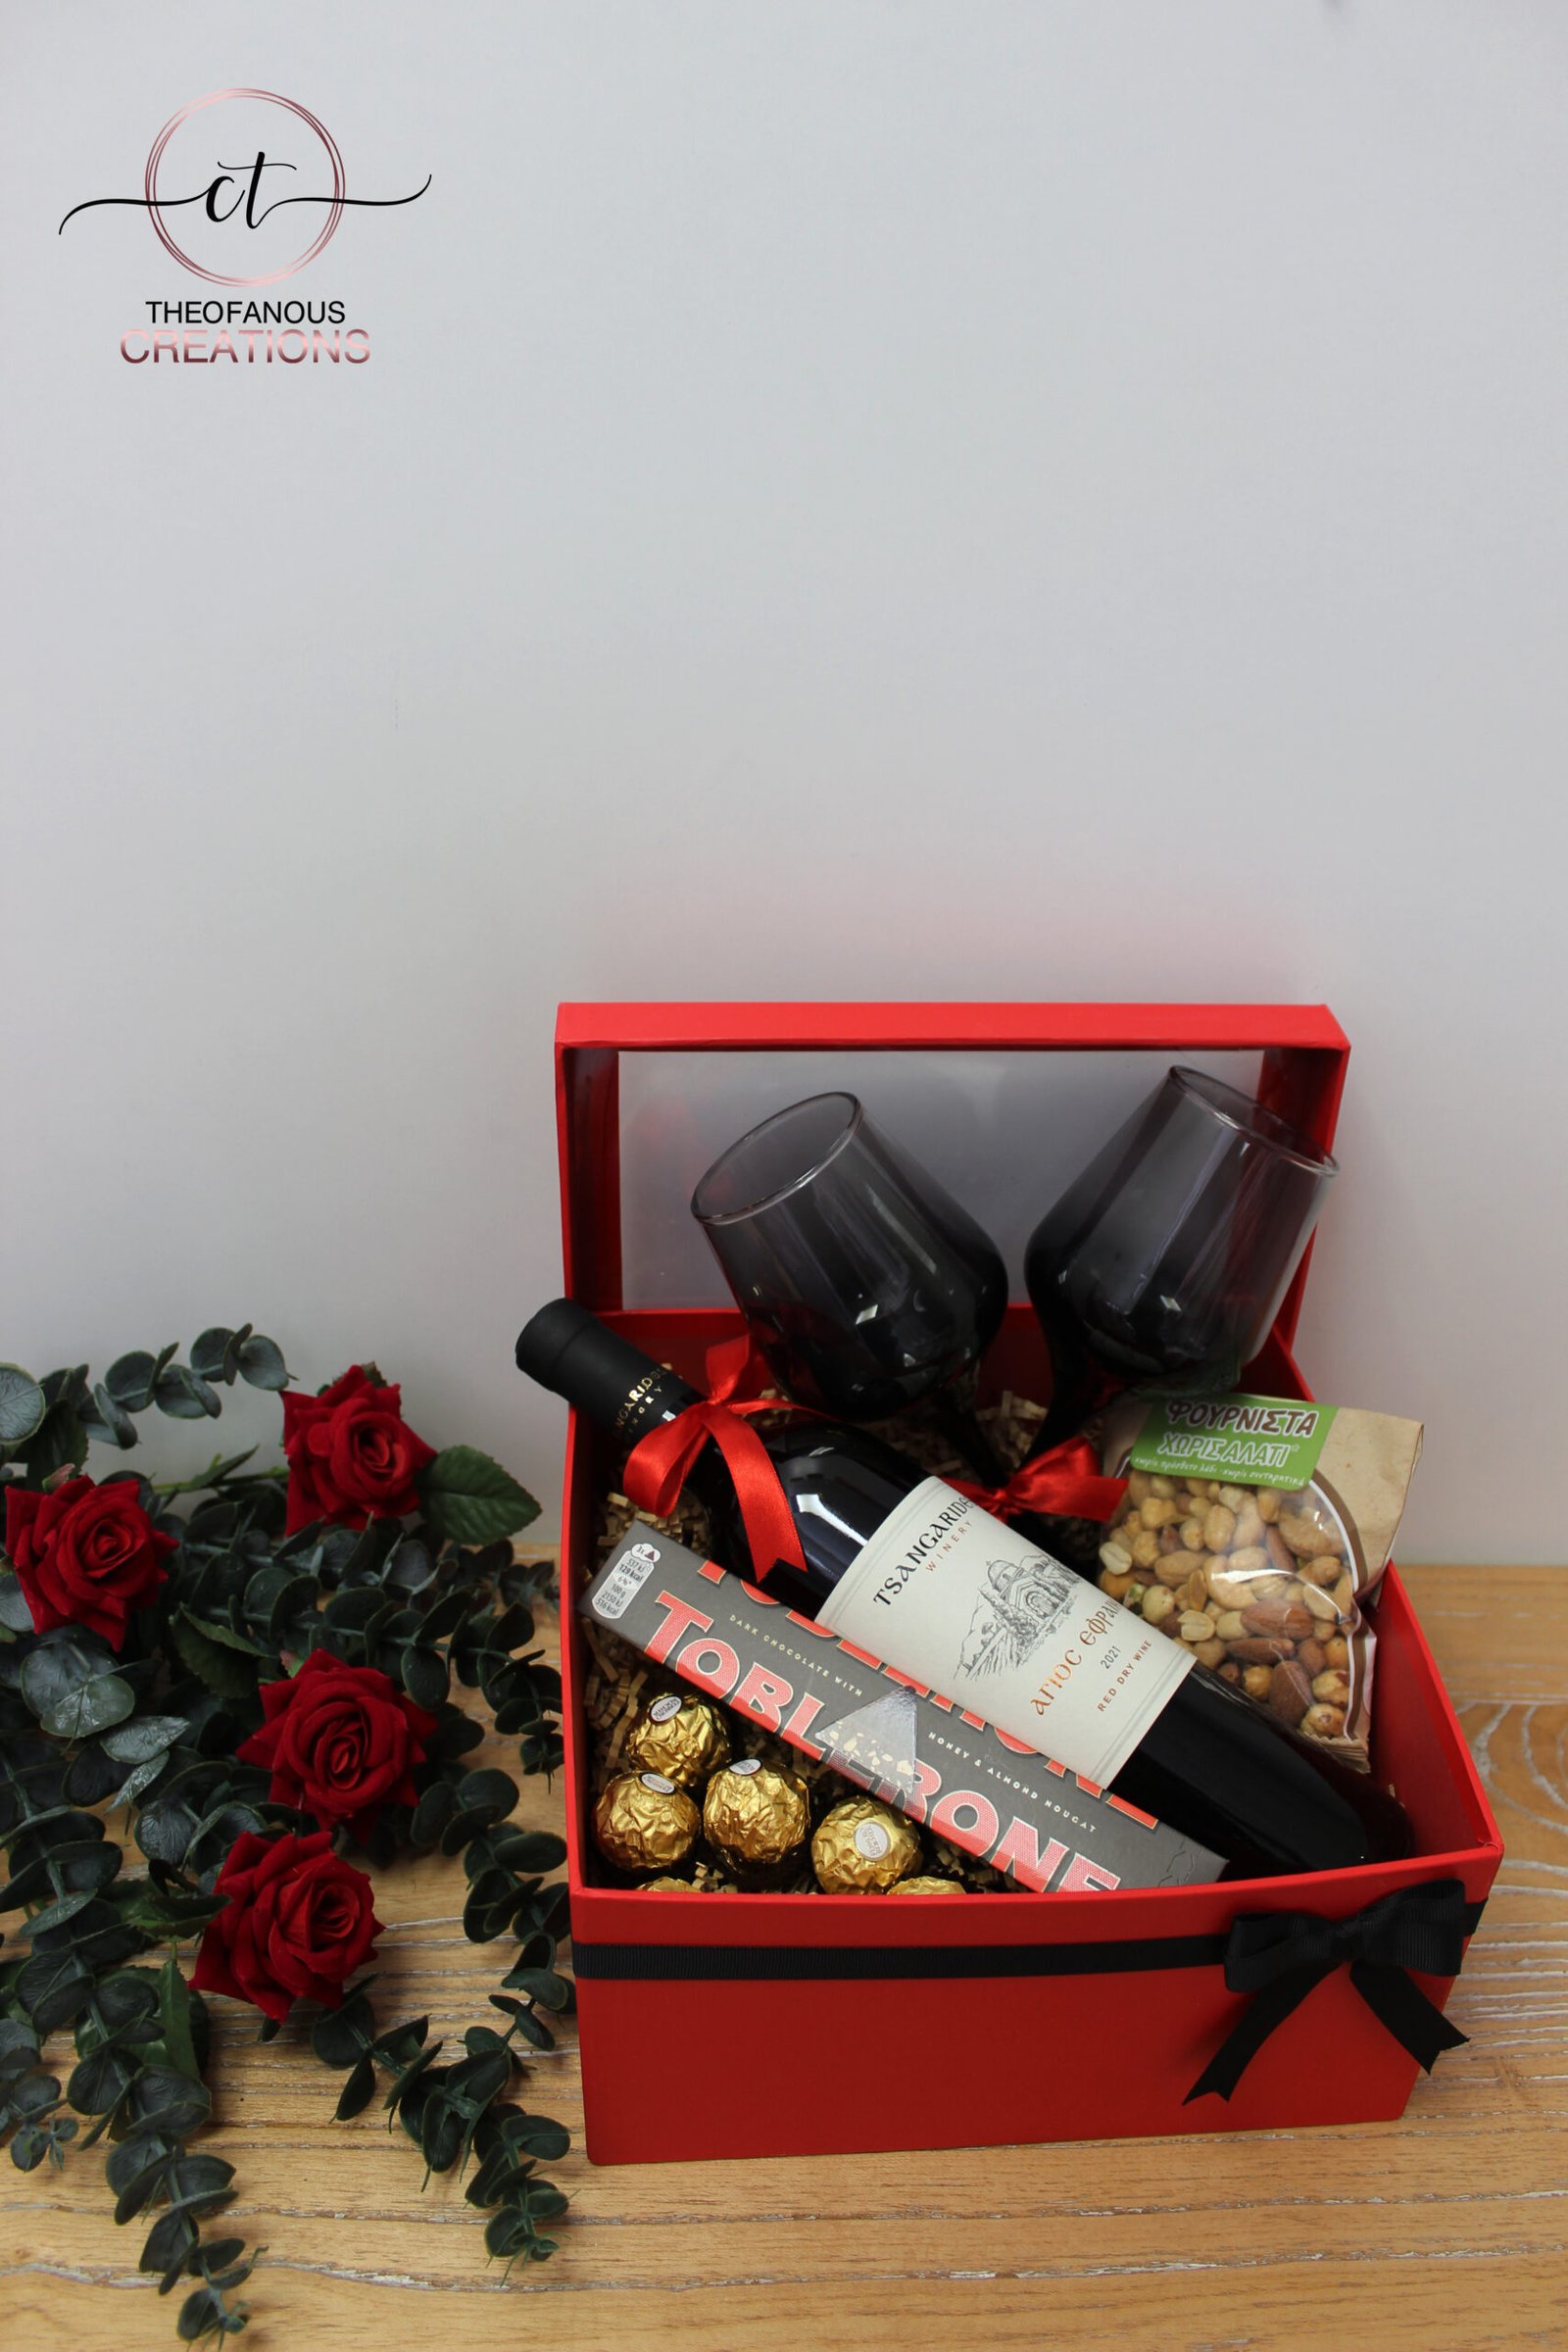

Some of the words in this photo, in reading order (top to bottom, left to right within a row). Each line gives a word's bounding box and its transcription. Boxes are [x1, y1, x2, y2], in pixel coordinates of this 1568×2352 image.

[1157, 1431, 1227, 1461] ΧΩΡΙΣ
[1166, 1401, 1319, 1439] ΦΟΥΡΝΙΣΤΑ
[873, 1496, 976, 1605] TSANGARIDE
[926, 1521, 971, 1572] WINERY
[729, 1614, 759, 1636] DARK
[763, 1635, 830, 1677] CHOCOLATE
[834, 1676, 862, 1697] WITH
[1098, 1688, 1117, 1711] RED
[1117, 1663, 1134, 1685] DRY
[1133, 1640, 1152, 1661] WINE
[1100, 1645, 1121, 1669] 2021
[928, 1732, 969, 1759] HONEY
[987, 1767, 1039, 1799] ALMOND
[1045, 1799, 1097, 1833] NOUGAT
